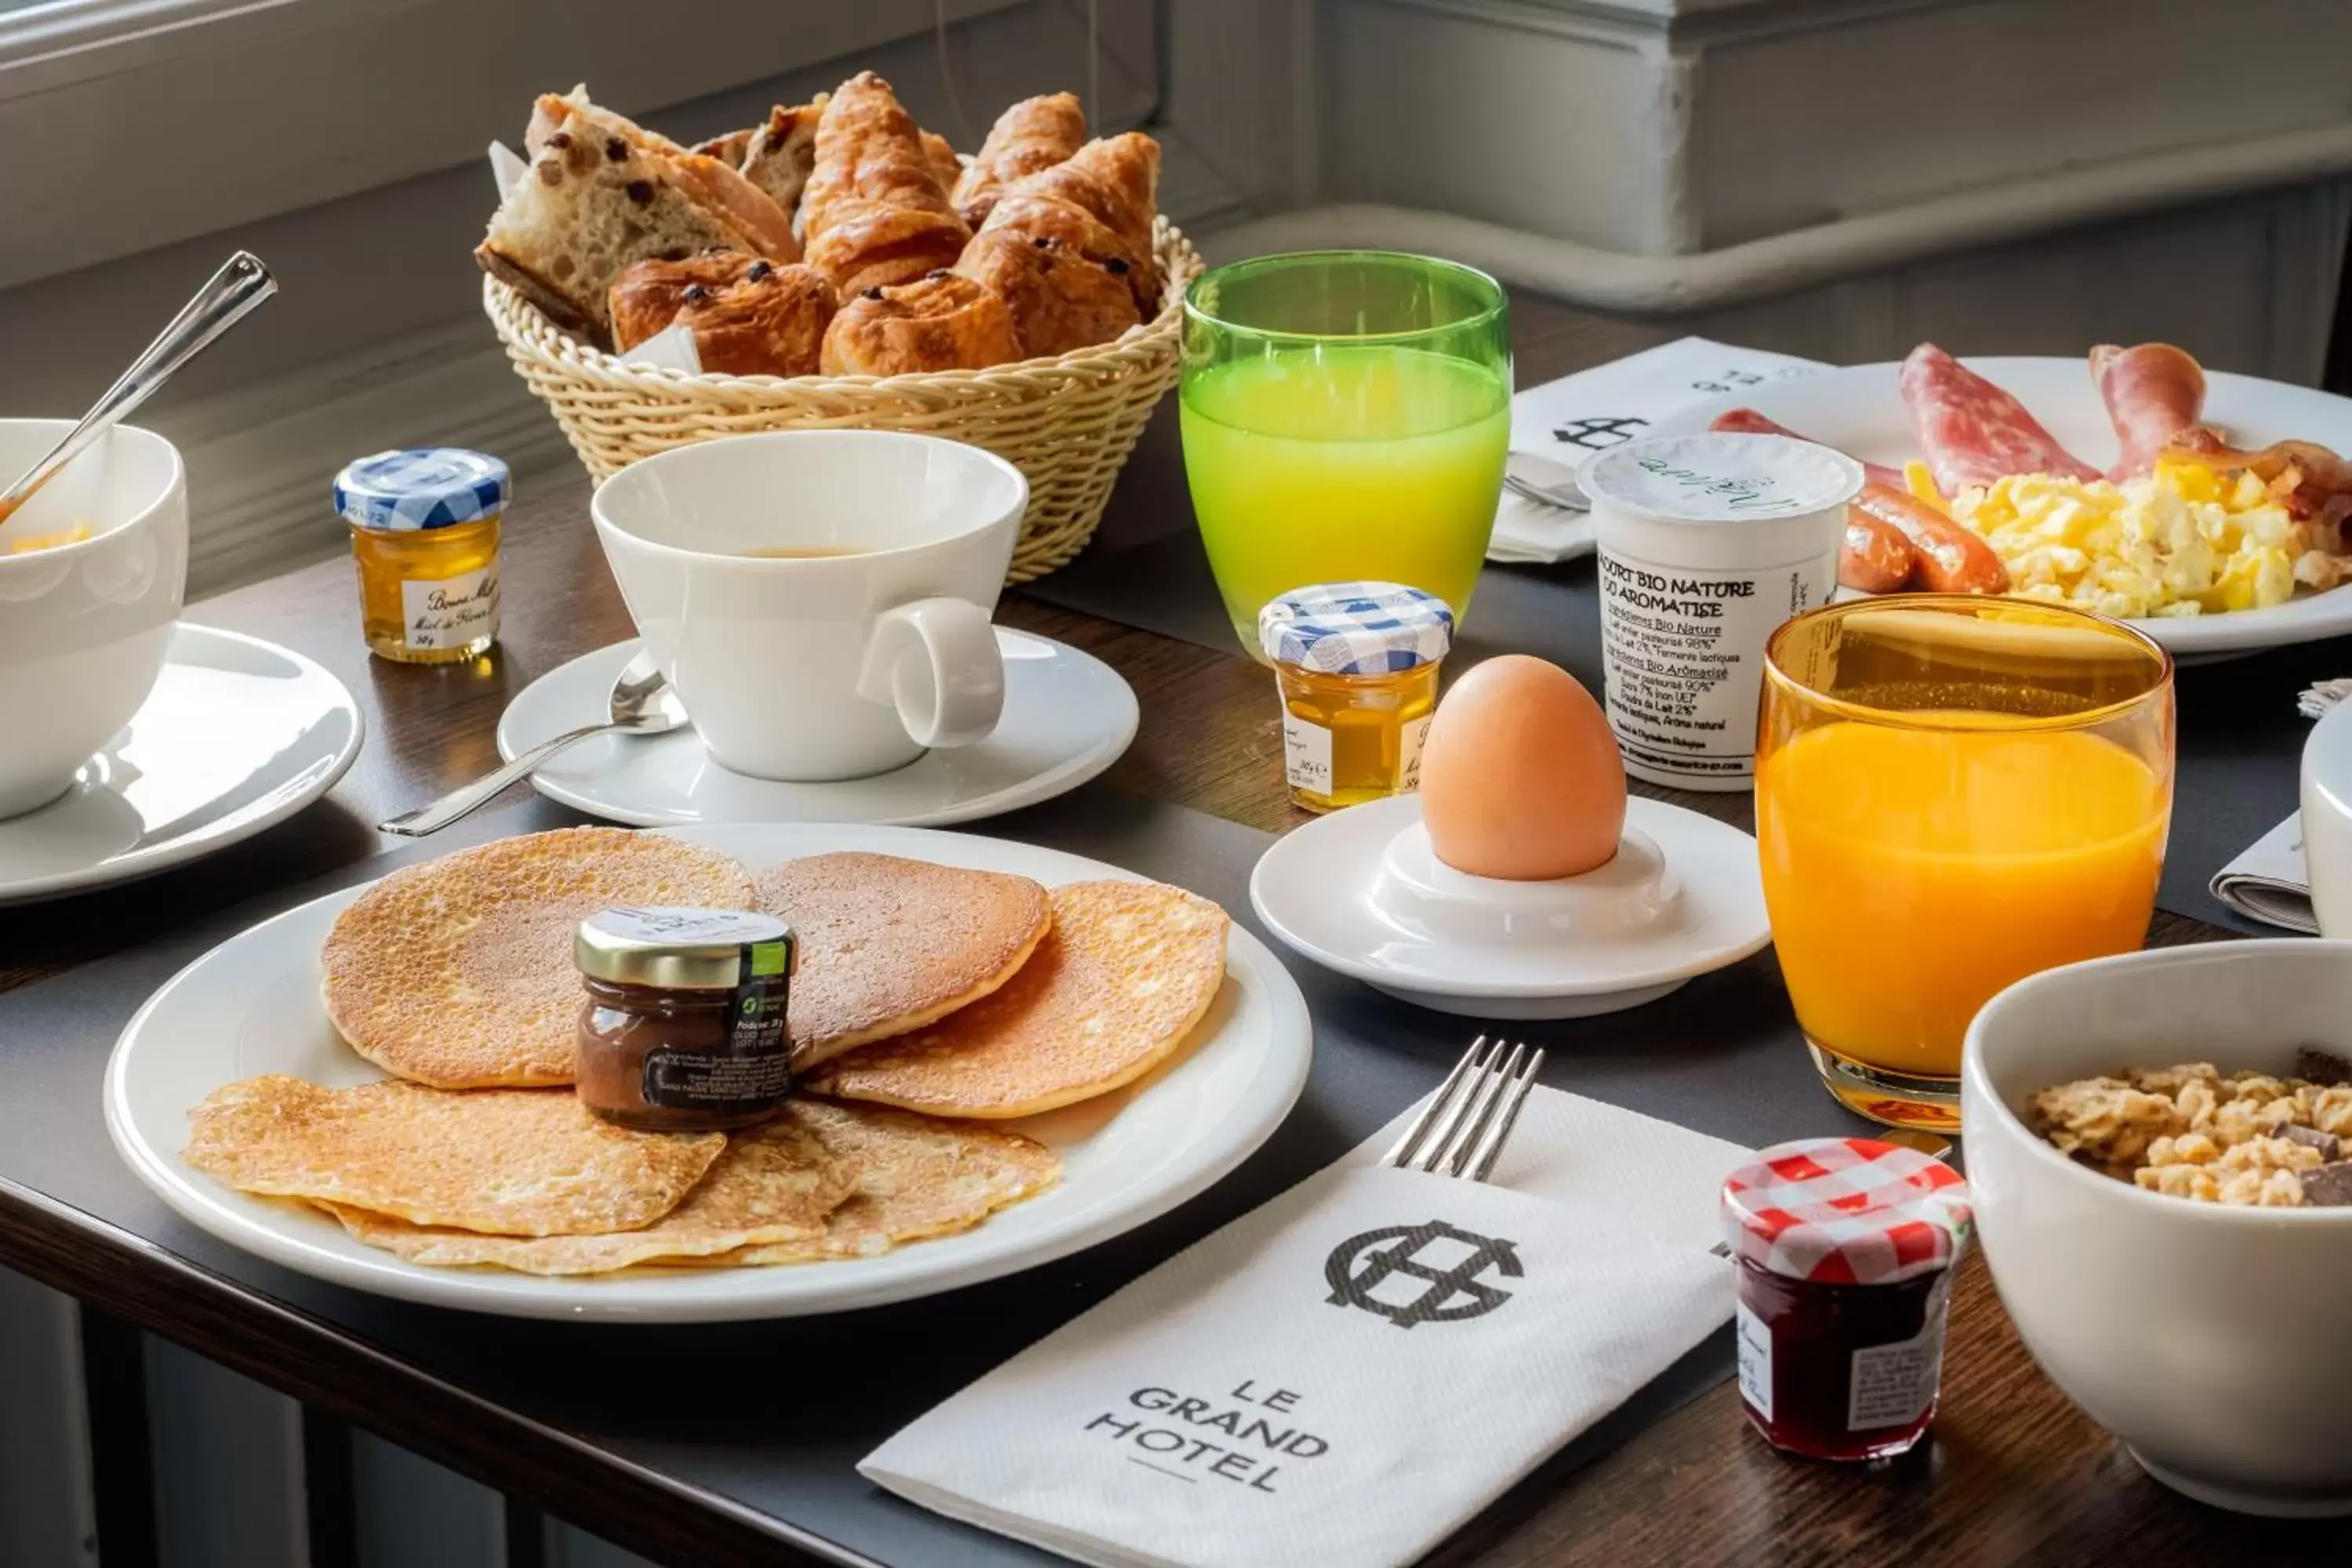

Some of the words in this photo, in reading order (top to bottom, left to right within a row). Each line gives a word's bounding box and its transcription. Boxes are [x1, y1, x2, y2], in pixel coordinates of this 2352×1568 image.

[1636, 570, 1666, 591] BIO
[1671, 579, 1755, 597] NATURE
[1655, 619, 1674, 632] Bio
[1677, 622, 1722, 636] Nature
[1646, 659, 1664, 673] Bio
[1231, 1380, 1302, 1414] LE
[1128, 1386, 1330, 1459] GRAND
[1083, 1412, 1283, 1493] HOTEL
